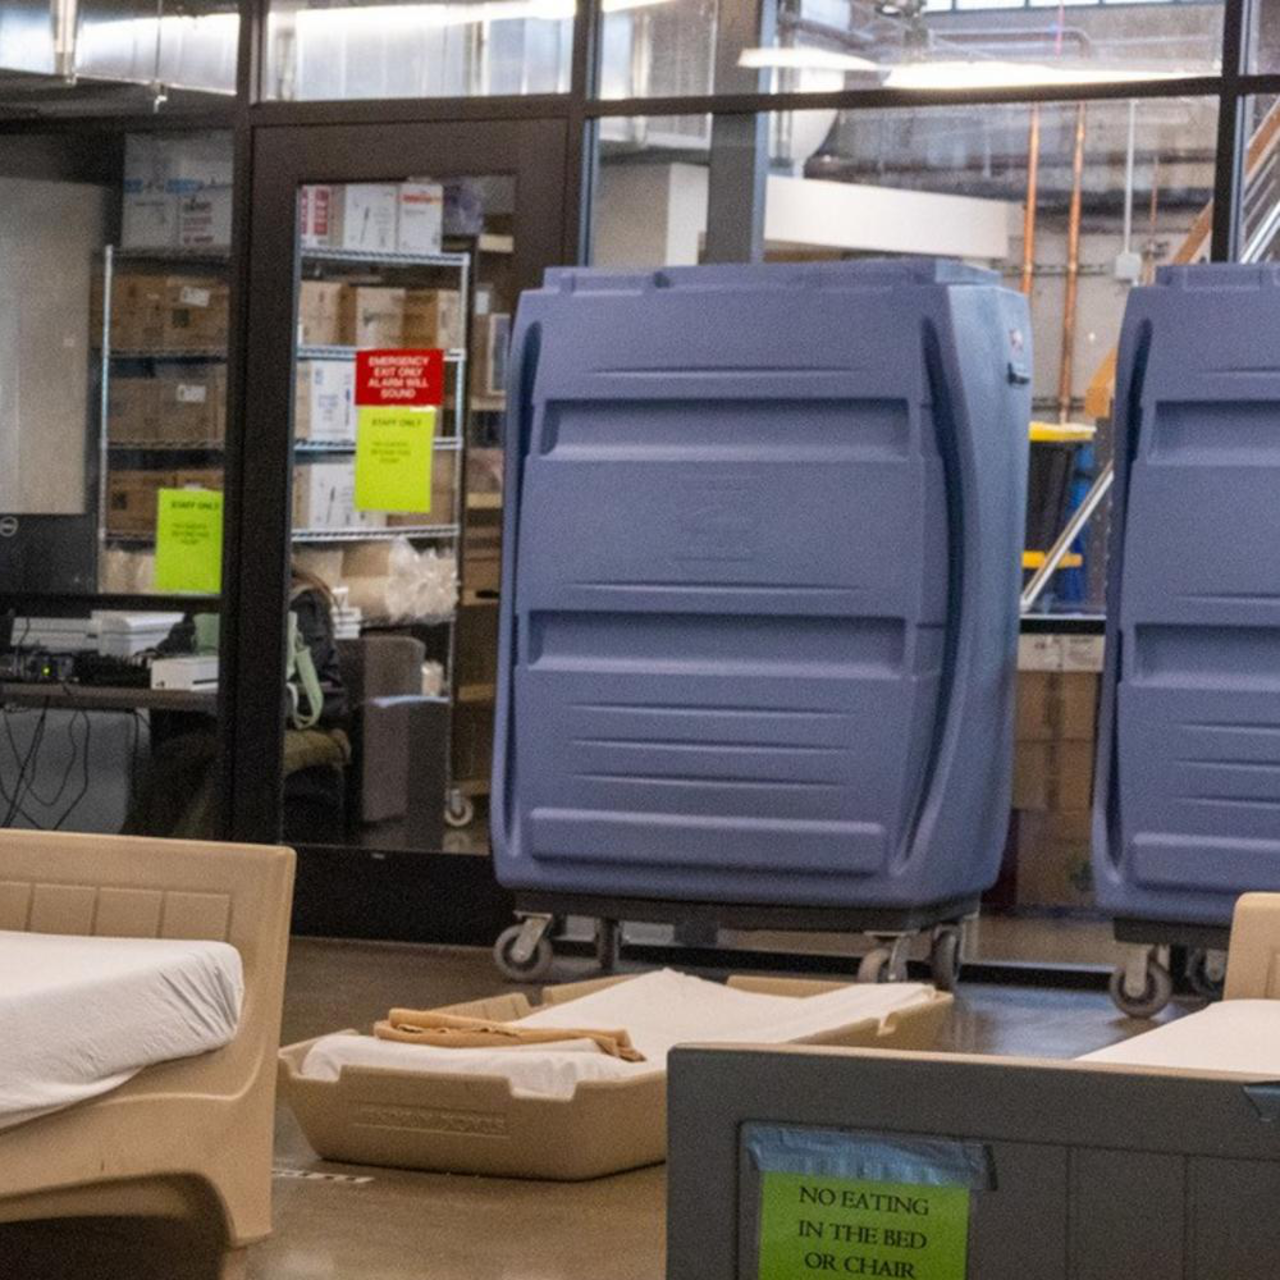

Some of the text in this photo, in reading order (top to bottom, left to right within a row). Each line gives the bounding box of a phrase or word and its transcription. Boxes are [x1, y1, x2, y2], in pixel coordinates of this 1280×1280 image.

[368, 355, 430, 367] EMERGENCY
[374, 366, 424, 377] EXIT ONLY
[367, 377, 430, 388] ALARM WILL
[380, 388, 416, 399] SOUND
[799, 1185, 929, 1216] NO EATING
[798, 1220, 927, 1250] IN THE BED
[804, 1252, 916, 1280] OR CHAIR
